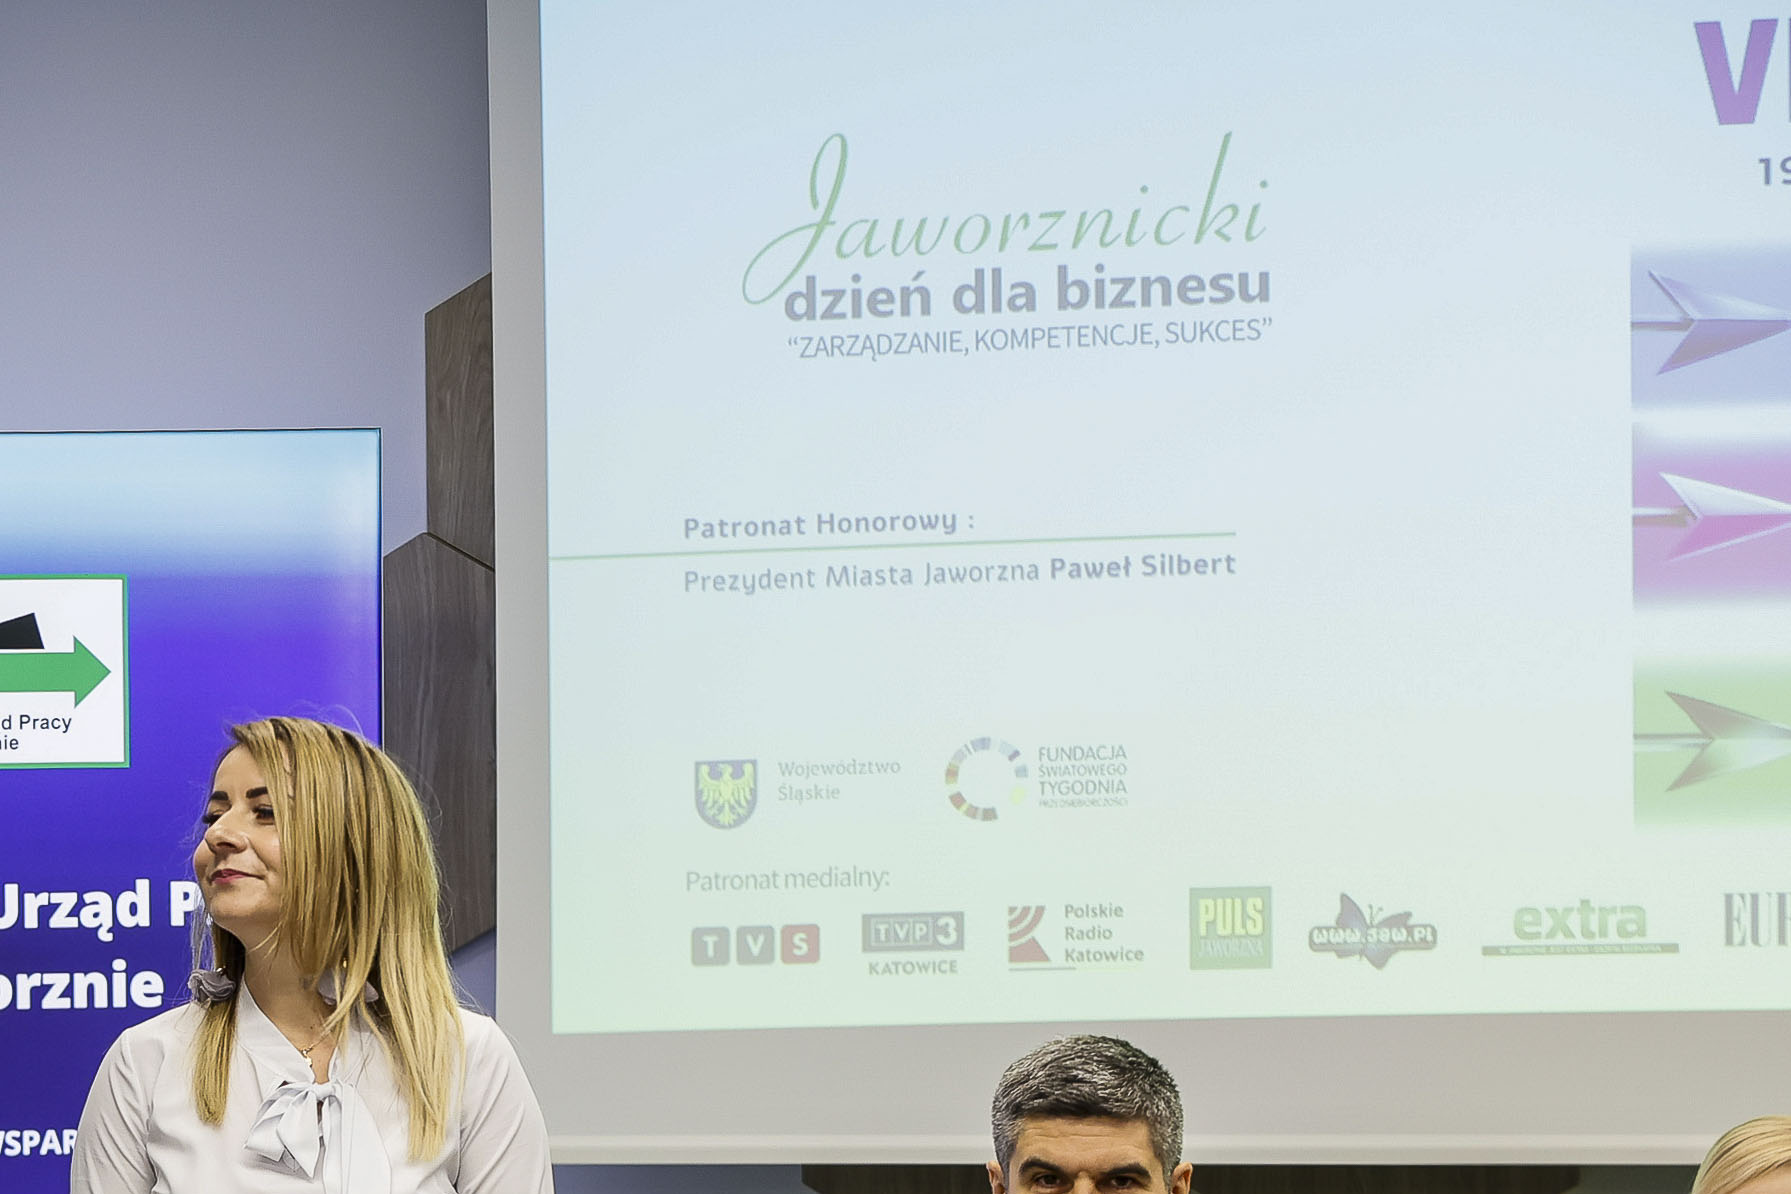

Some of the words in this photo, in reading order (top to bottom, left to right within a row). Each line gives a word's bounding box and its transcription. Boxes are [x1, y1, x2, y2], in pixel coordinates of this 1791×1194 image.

[742, 131, 1269, 305] Jaworznicki
[784, 271, 932, 321] dzień
[952, 266, 1036, 314] dla
[1056, 263, 1271, 311] biznesu
[974, 322, 1160, 352] KOMPETENCJE,
[683, 516, 807, 540] Patronat
[815, 511, 958, 535] Honorowy
[683, 569, 816, 595] Prezydent
[825, 565, 913, 589] Miasta
[923, 559, 1040, 586] Jaworzna
[1049, 556, 1131, 581] Paweł
[1140, 553, 1237, 578] Silbert
[19, 714, 72, 734] Pracy
[1038, 745, 1128, 762] FUNDACJA
[778, 759, 902, 778] Województwo
[777, 784, 841, 804] Śląskie
[1039, 779, 1128, 796] TYGODNIA
[686, 870, 779, 891] Patronat
[785, 865, 890, 892] medialny:
[1065, 903, 1124, 919] Polskie
[1198, 896, 1264, 937] PULS
[1513, 898, 1648, 941] extra
[1065, 925, 1113, 941] Radio
[1065, 947, 1144, 963] Katowice
[868, 960, 958, 976] KATOWICE
